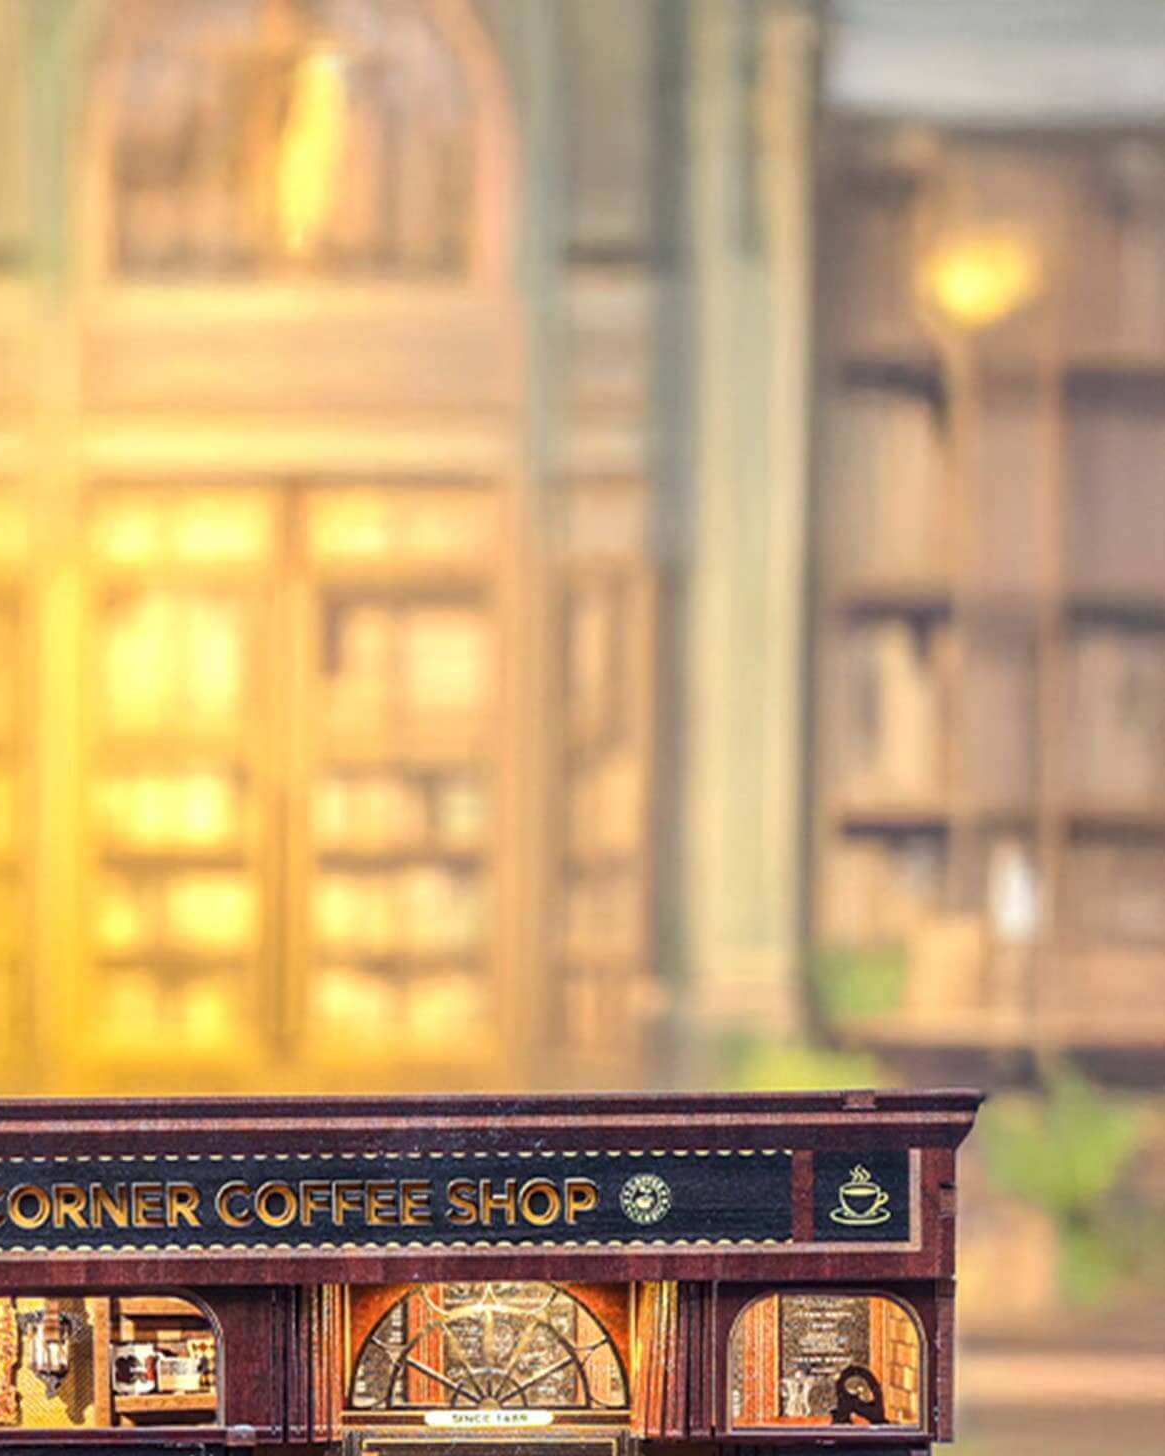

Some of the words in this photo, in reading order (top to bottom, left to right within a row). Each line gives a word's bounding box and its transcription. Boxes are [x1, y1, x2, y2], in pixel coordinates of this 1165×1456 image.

[215, 1179, 433, 1228] COFFEE
[445, 1177, 599, 1226] SHOP
[452, 1413, 490, 1424] SINCE
